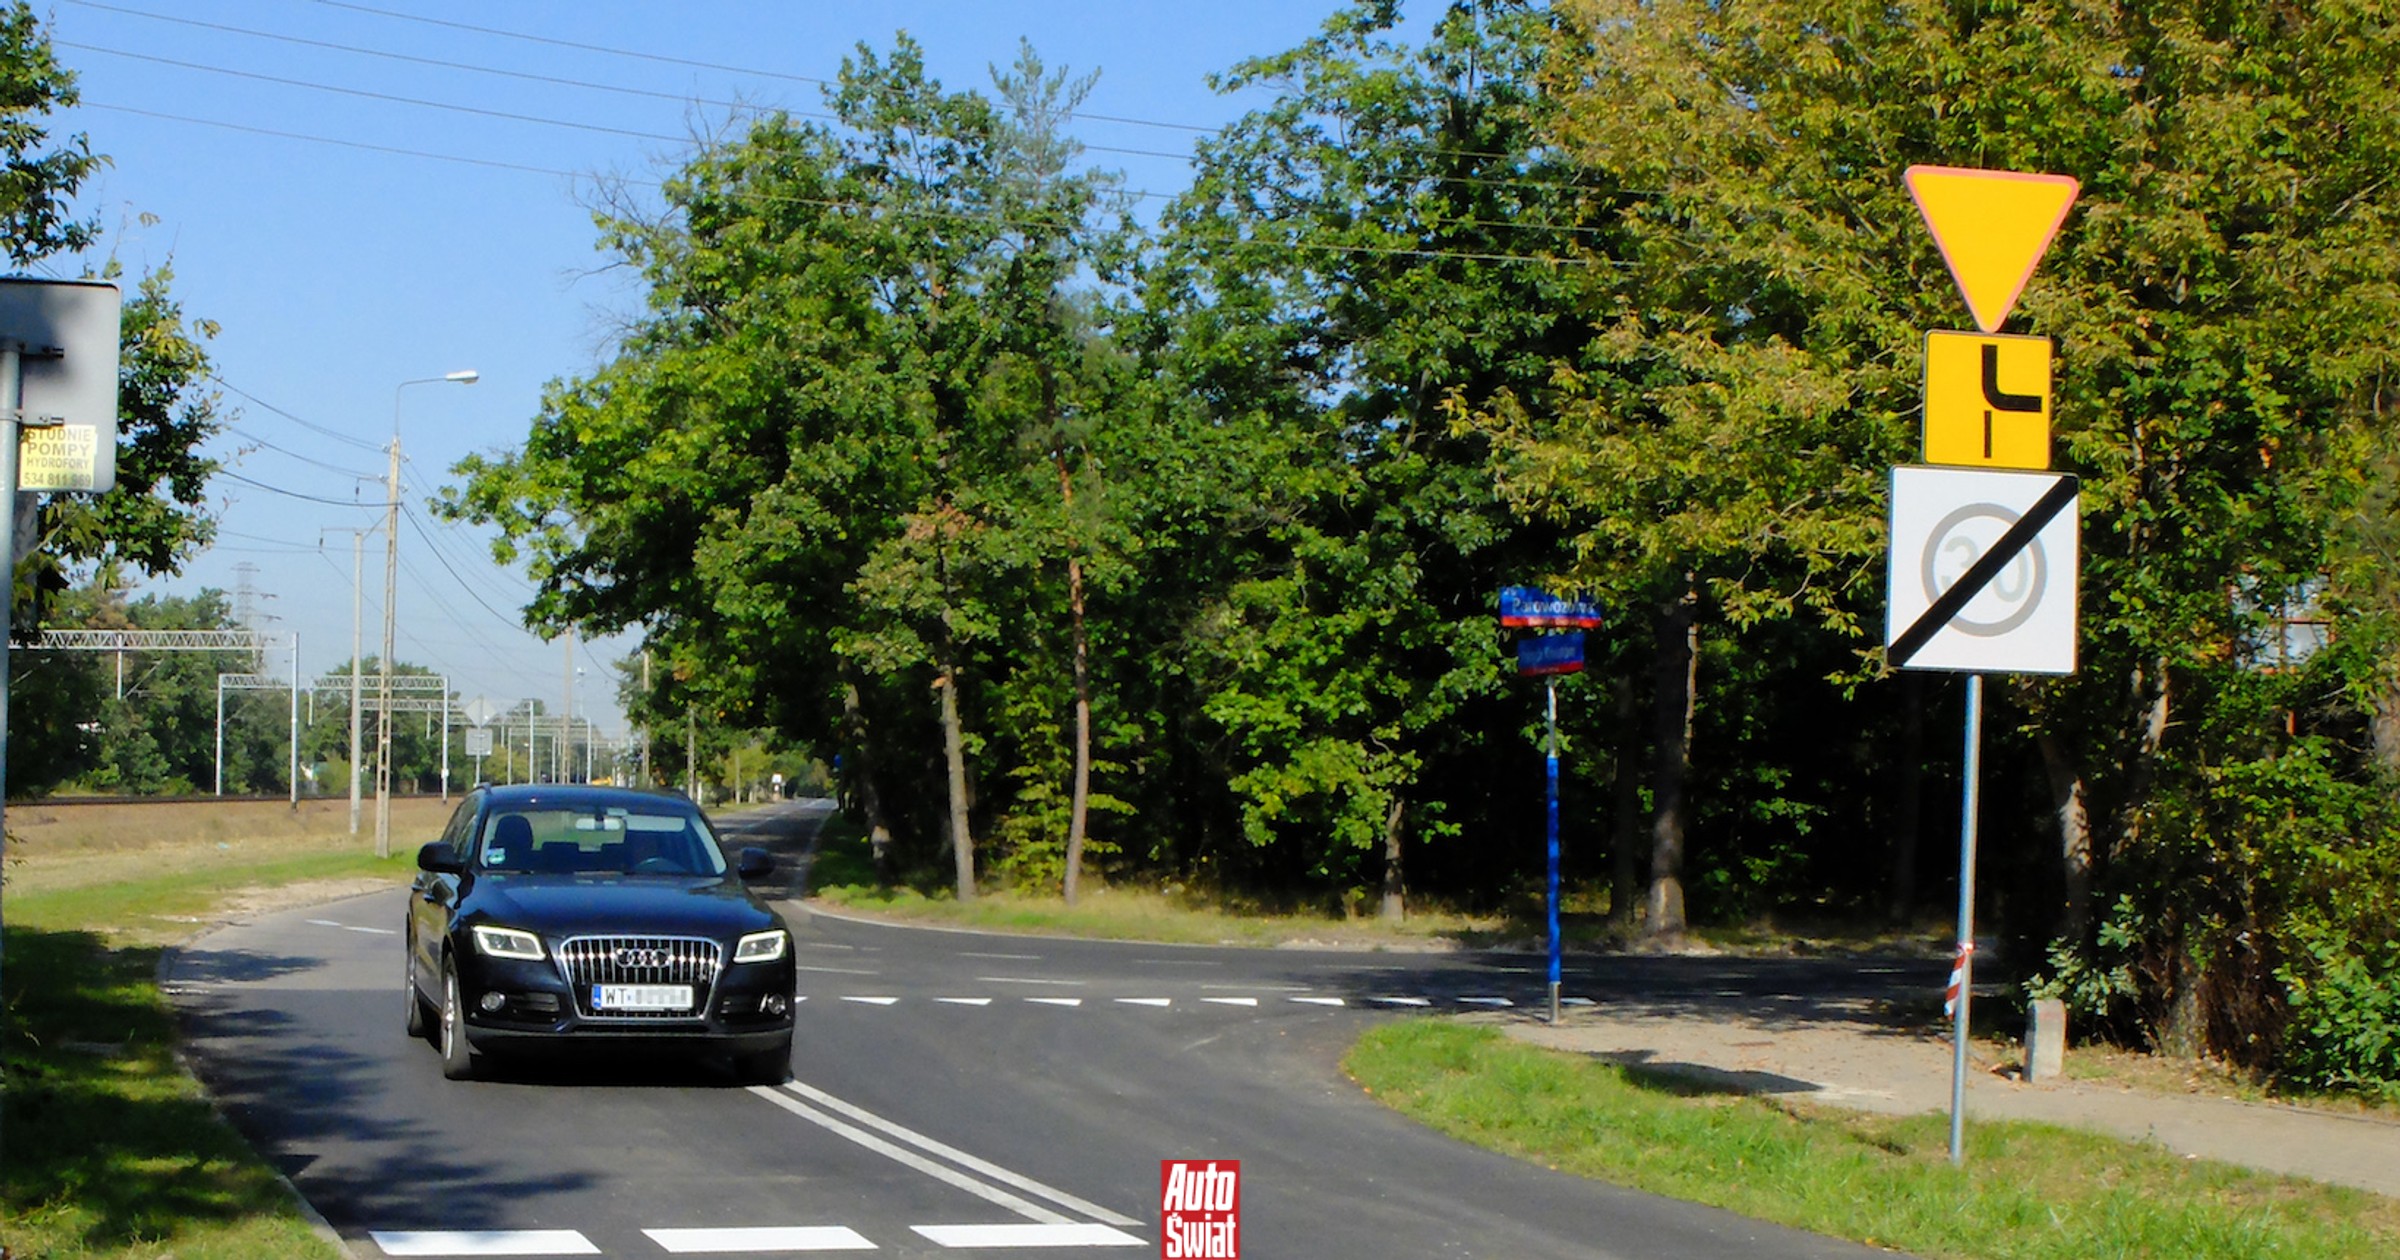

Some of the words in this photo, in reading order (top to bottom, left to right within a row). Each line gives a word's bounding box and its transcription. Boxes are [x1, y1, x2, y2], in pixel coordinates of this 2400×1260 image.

[28, 428, 91, 442] STUDNIE
[27, 442, 91, 456] POMPY
[26, 457, 90, 470] HYDROFORY
[25, 472, 43, 485] 534
[47, 473, 67, 486] 811
[1942, 535, 2028, 603] 30
